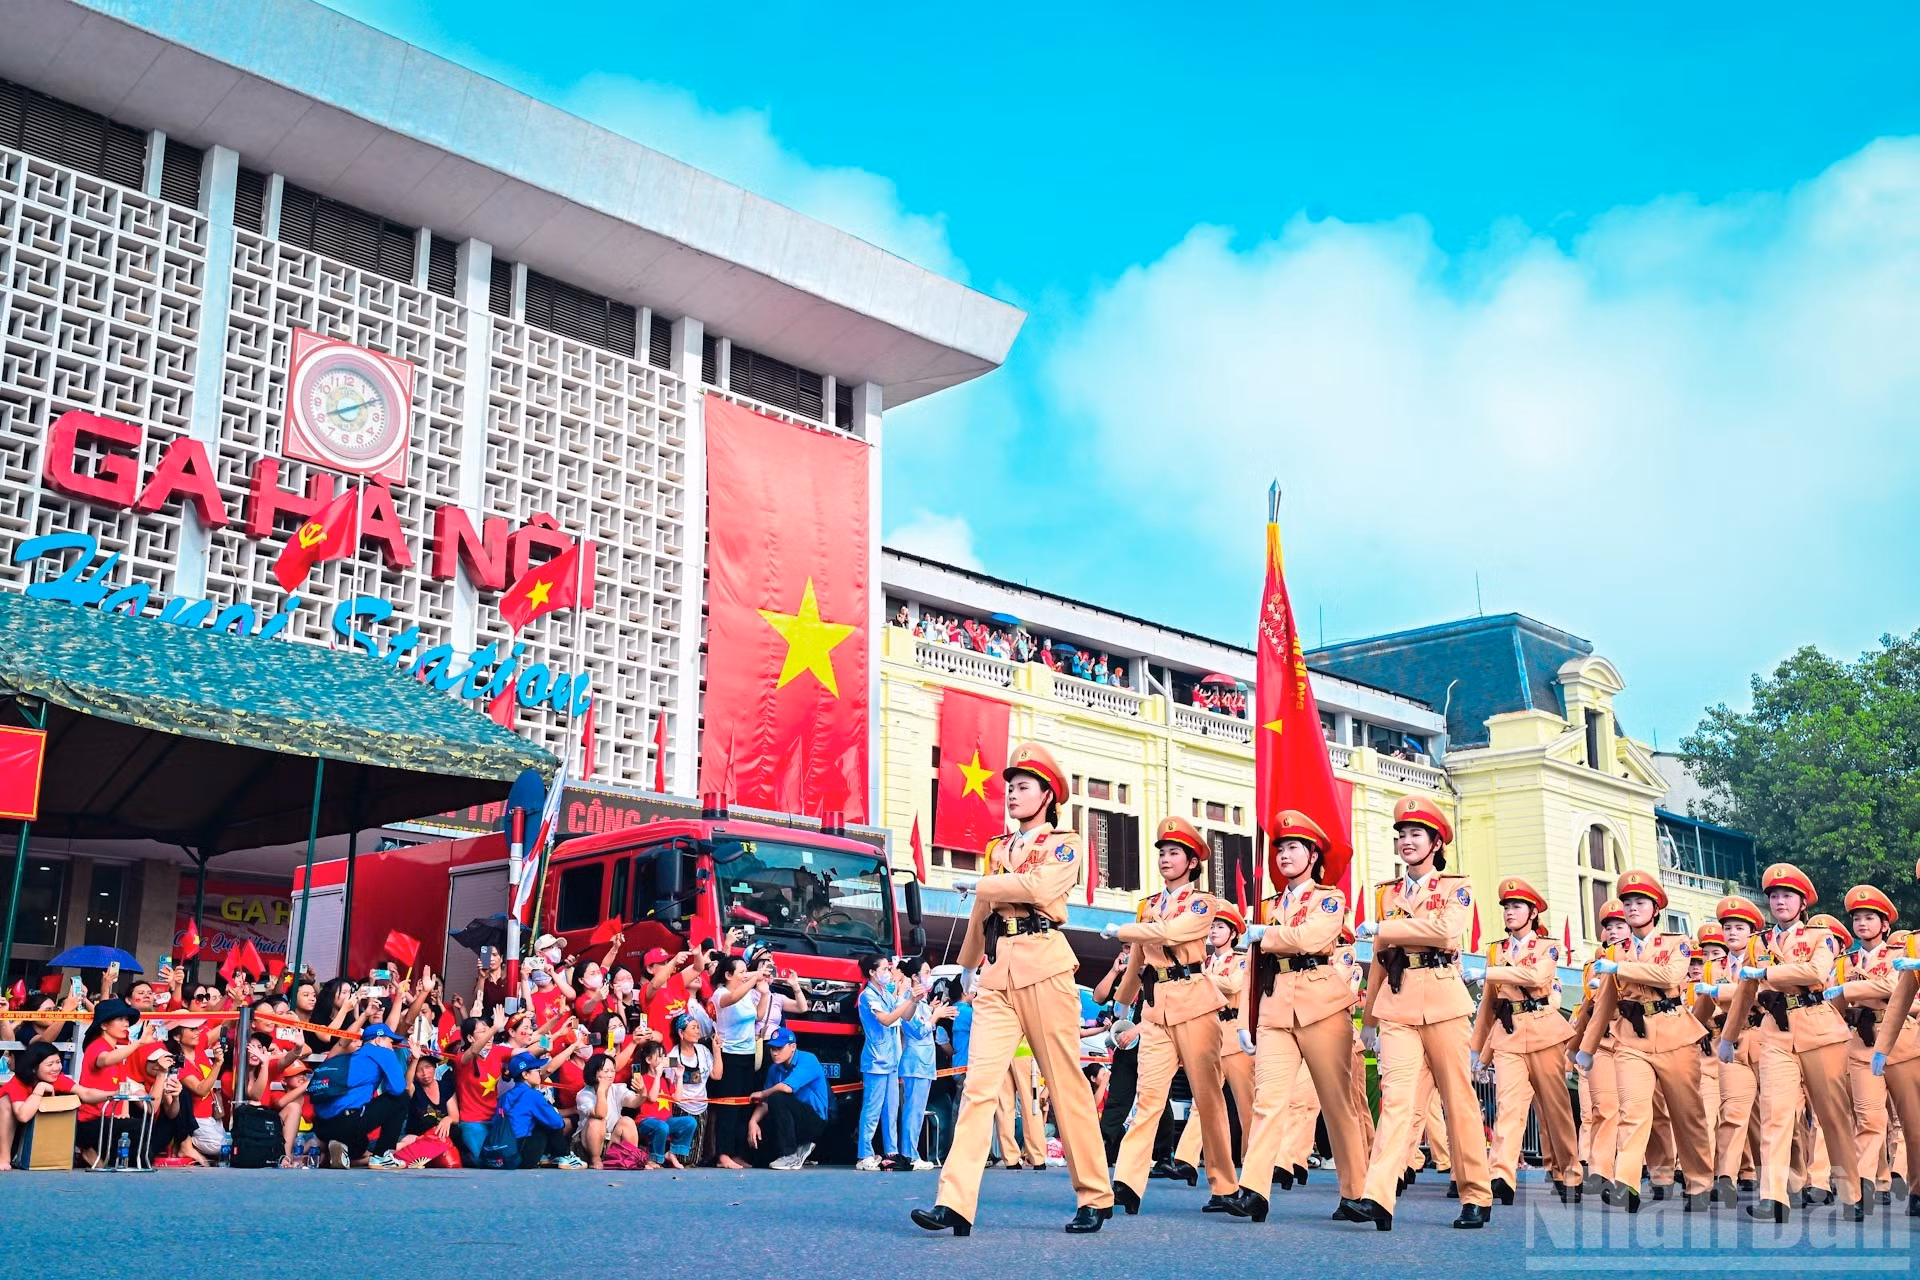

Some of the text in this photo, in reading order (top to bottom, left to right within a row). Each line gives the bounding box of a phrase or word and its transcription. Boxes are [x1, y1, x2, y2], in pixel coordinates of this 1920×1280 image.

[330, 375, 339, 387] 11
[343, 375, 355, 387] 12
[318, 383, 331, 395] 10
[361, 384, 366, 394] 1
[314, 395, 322, 406] 9
[372, 412, 380, 423] 3
[328, 426, 336, 437] 7
[365, 426, 375, 436] 4
[341, 433, 350, 444] 6
[356, 433, 364, 444] 5
[43, 410, 229, 532] GA
[246, 458, 414, 572] HÀ
[335, 596, 591, 717] Station
[568, 798, 641, 833] CÔNG
[221, 897, 268, 925] GA
[807, 1000, 841, 1014] AN
